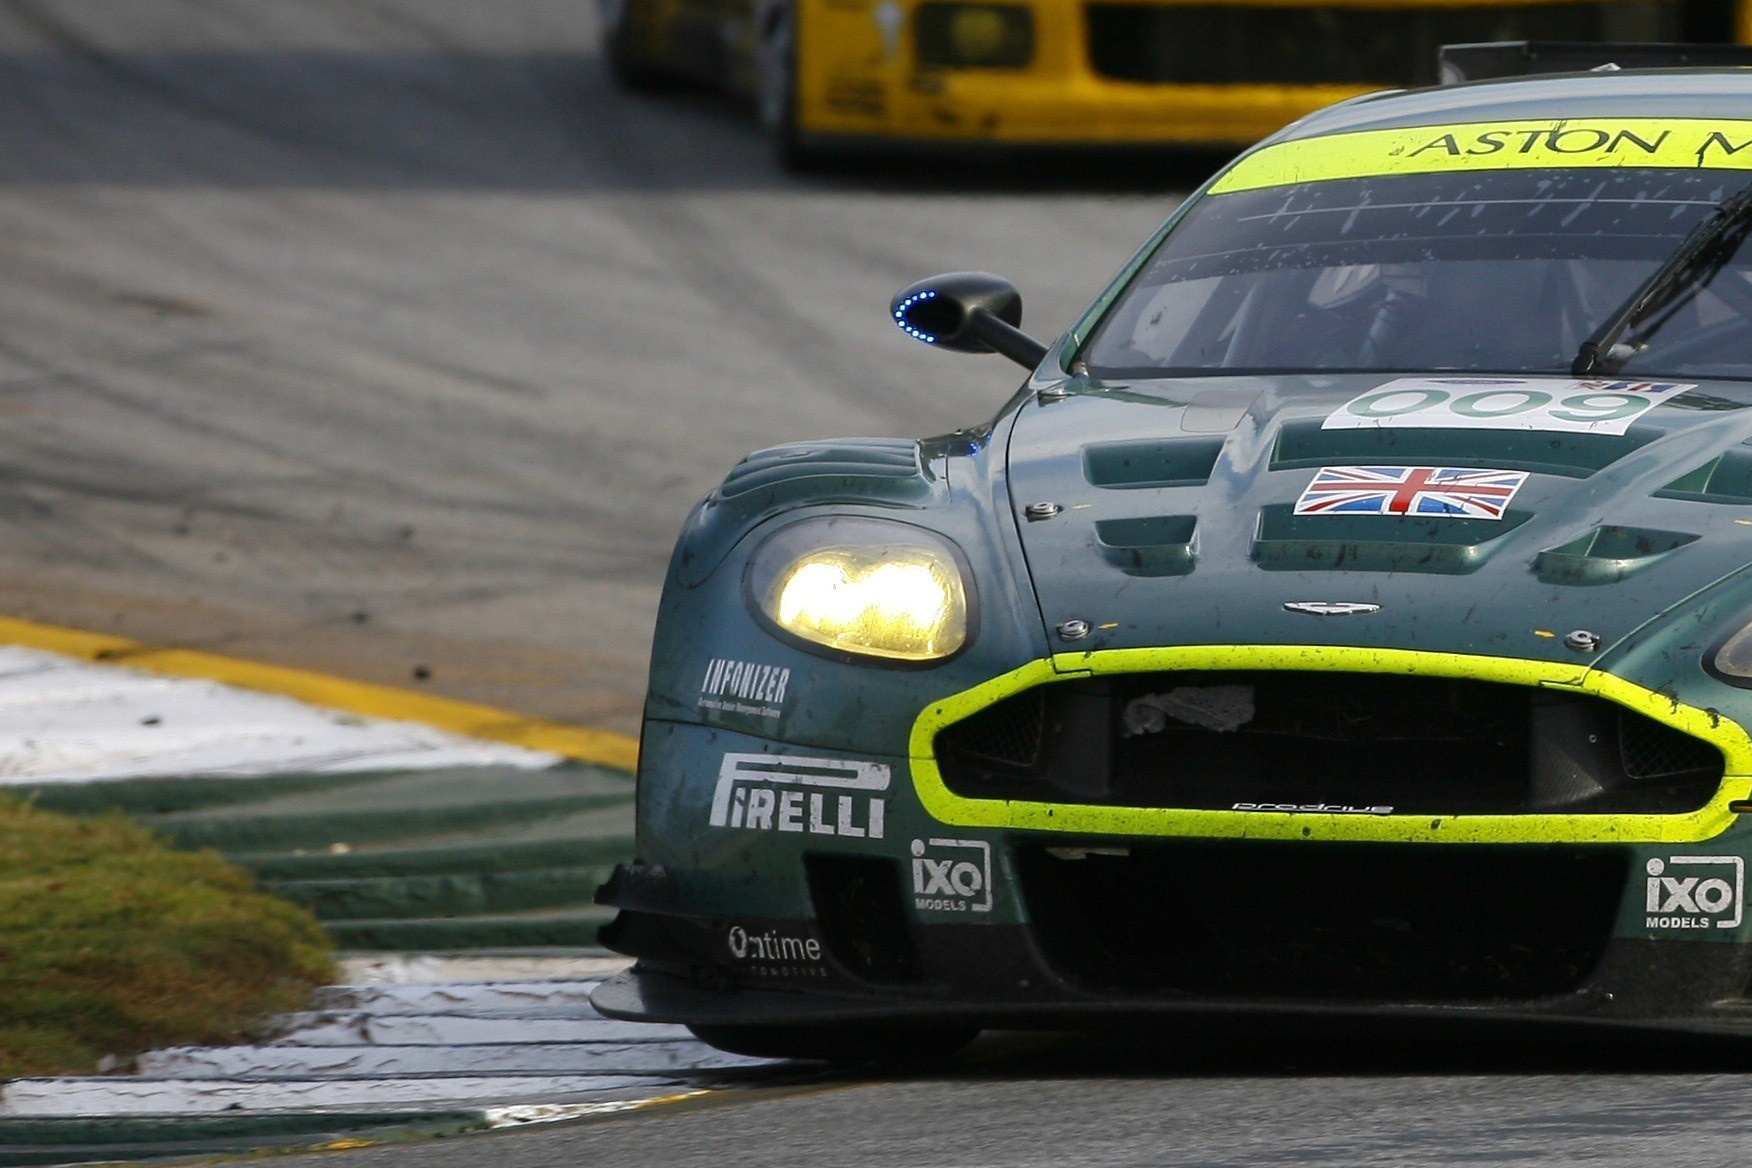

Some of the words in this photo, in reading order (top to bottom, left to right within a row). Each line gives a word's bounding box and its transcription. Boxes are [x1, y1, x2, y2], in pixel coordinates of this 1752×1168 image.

[1407, 128, 1672, 158] ASTON
[1346, 388, 1651, 423] 009
[701, 658, 790, 704] INFONIZER
[709, 752, 891, 839] PIRELLI
[915, 898, 966, 912] MODELS
[1645, 916, 1710, 929] MODELS
[729, 925, 821, 961] Ontime
